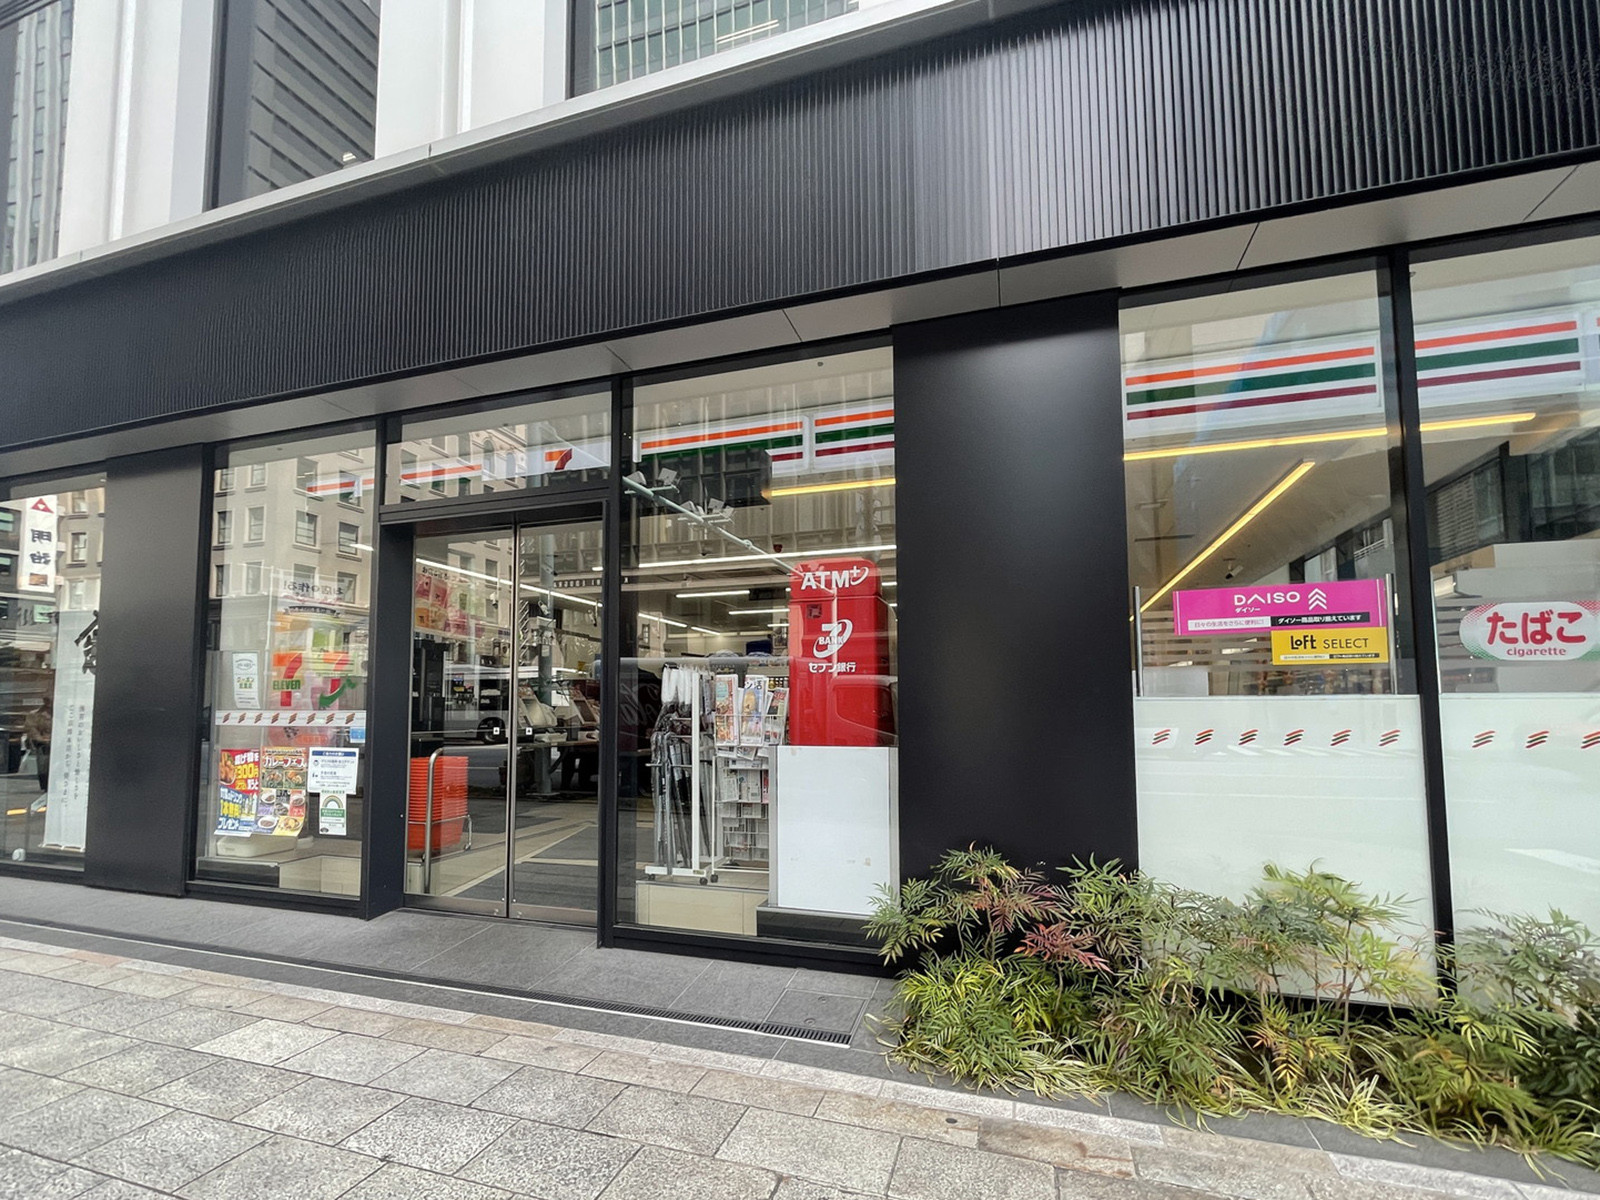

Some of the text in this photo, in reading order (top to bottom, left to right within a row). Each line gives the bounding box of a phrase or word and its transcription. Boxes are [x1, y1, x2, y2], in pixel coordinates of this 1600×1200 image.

[1234, 591, 1300, 605] DAISO
[1486, 609, 1586, 645] たばこ
[1323, 638, 1369, 649] SELECT
[1506, 647, 1567, 657] cigarette
[808, 662, 857, 673] セブン銀行
